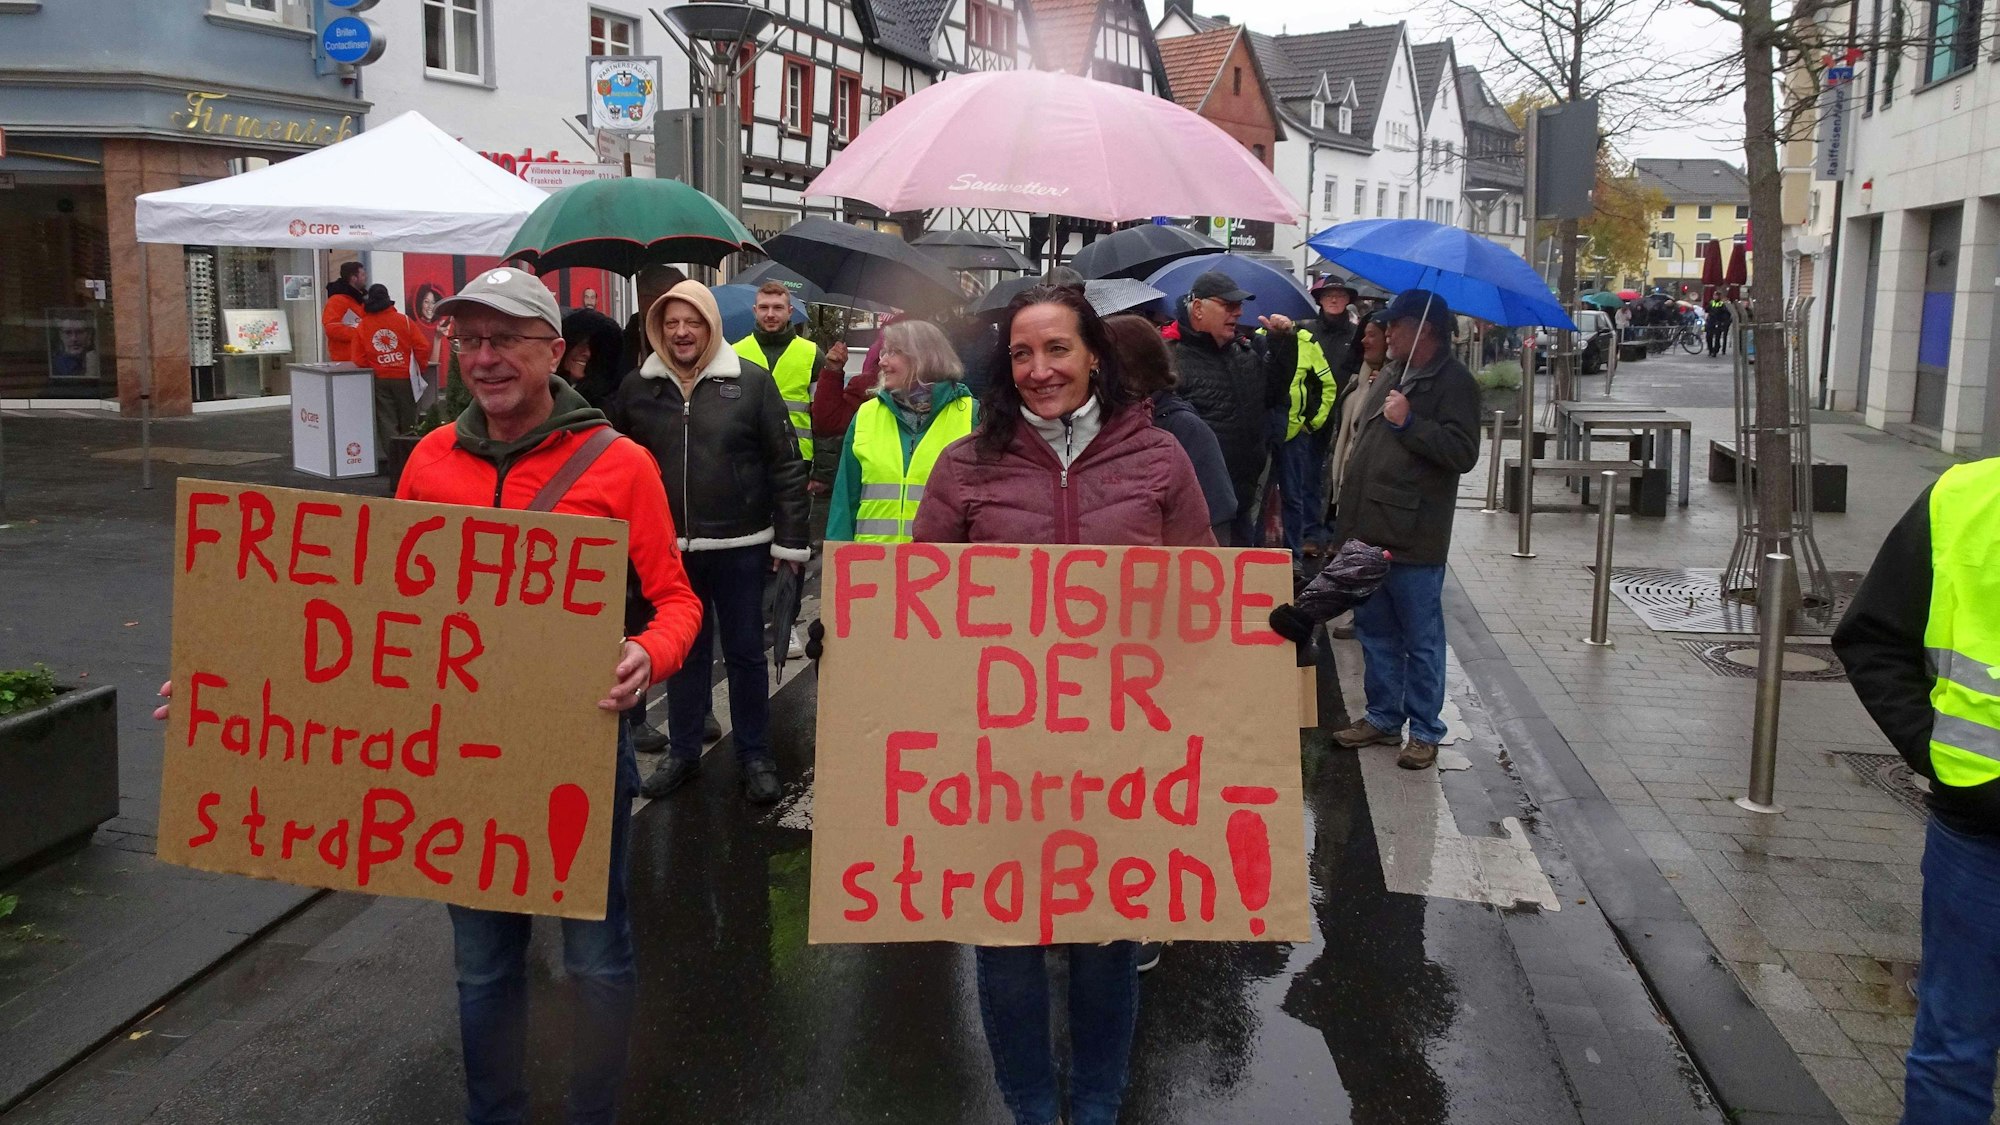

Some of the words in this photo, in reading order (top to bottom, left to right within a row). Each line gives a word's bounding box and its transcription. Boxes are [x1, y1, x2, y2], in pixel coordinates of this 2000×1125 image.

[336, 28, 357, 37] Brillen
[530, 166, 561, 175] Villeneuve
[572, 166, 595, 177] Avignon
[530, 177, 563, 185] Frankreich
[948, 173, 1070, 197] Sauwetter!
[308, 223, 340, 235] care
[377, 351, 404, 364] care
[307, 412, 319, 424] care
[346, 456, 362, 465] care
[186, 491, 618, 616] FREIGABE
[833, 546, 1290, 647] FREIGABE
[304, 598, 485, 693] DER
[976, 643, 1172, 733] DER
